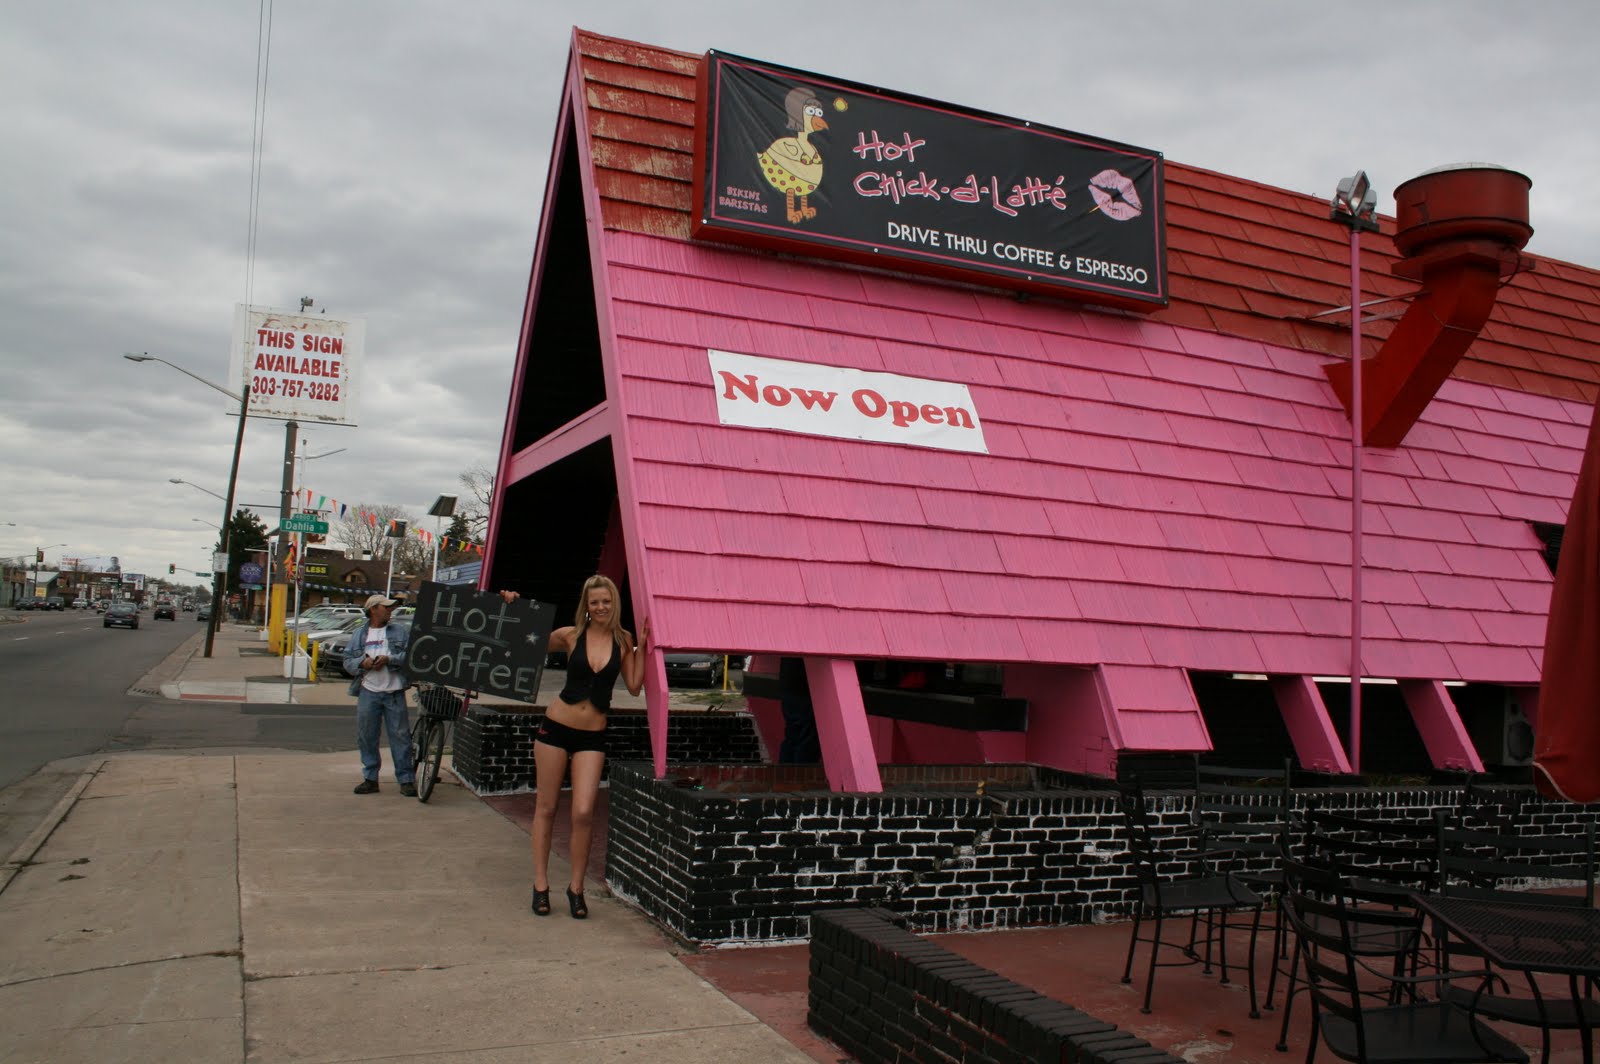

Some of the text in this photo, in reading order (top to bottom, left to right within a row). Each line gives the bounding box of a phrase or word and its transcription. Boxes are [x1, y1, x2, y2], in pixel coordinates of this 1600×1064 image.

[852, 130, 926, 162] Hot
[719, 196, 768, 214] BARISTAS
[726, 186, 761, 202] BIKINI
[887, 221, 1149, 285] DRIVE THRU COFFEE & ESPRESSO
[257, 329, 343, 354] THIS SIGN
[254, 353, 340, 378] AVAILABLE
[252, 376, 339, 401] 303-757-3282
[718, 370, 976, 430] Now Open
[285, 520, 315, 532] Dahlia
[305, 565, 327, 574] LESS
